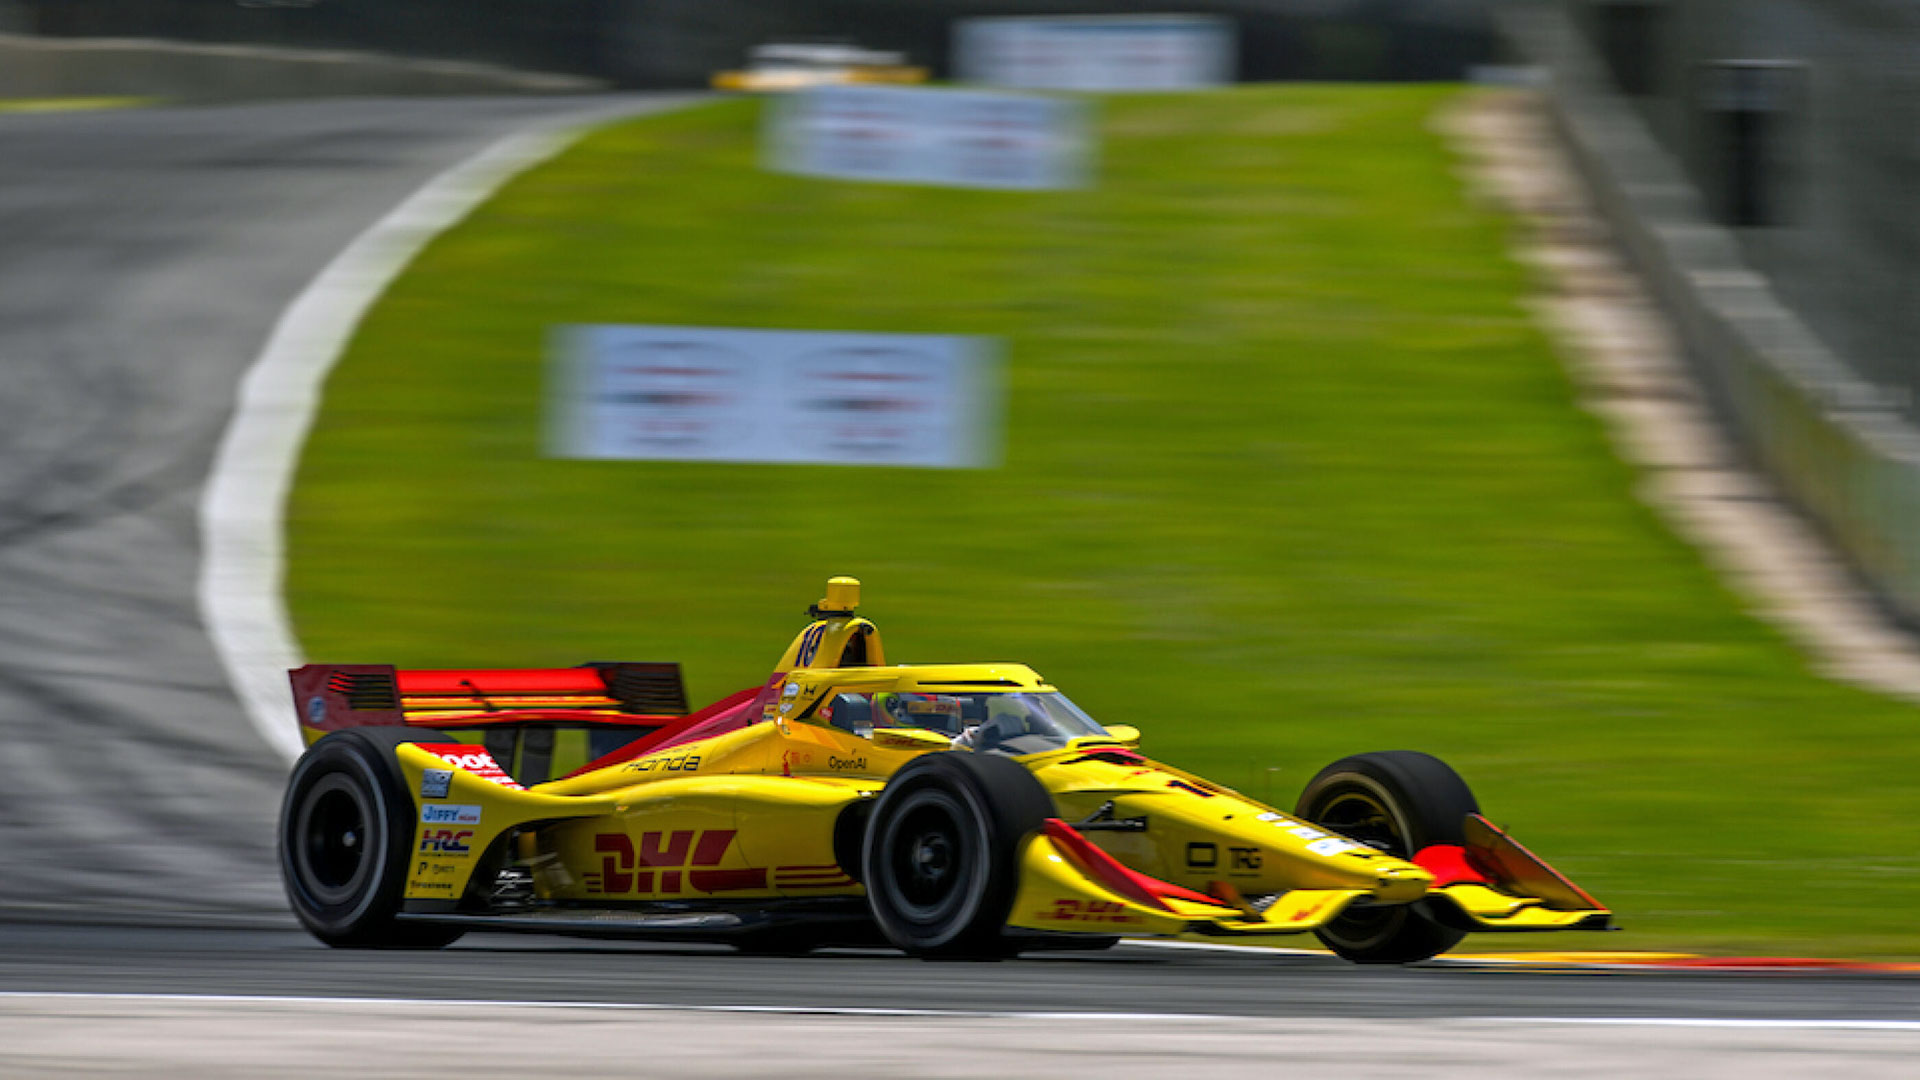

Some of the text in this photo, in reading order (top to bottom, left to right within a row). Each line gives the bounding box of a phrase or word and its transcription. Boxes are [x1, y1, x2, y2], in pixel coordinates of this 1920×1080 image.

[795, 625, 827, 668] 10
[430, 752, 498, 769] oot
[621, 753, 701, 773] Honda
[829, 755, 867, 770] OpenAI
[419, 829, 474, 852] HRC
[595, 830, 767, 893] DHL
[1228, 847, 1262, 869] TRG
[1053, 899, 1132, 922] DHL
